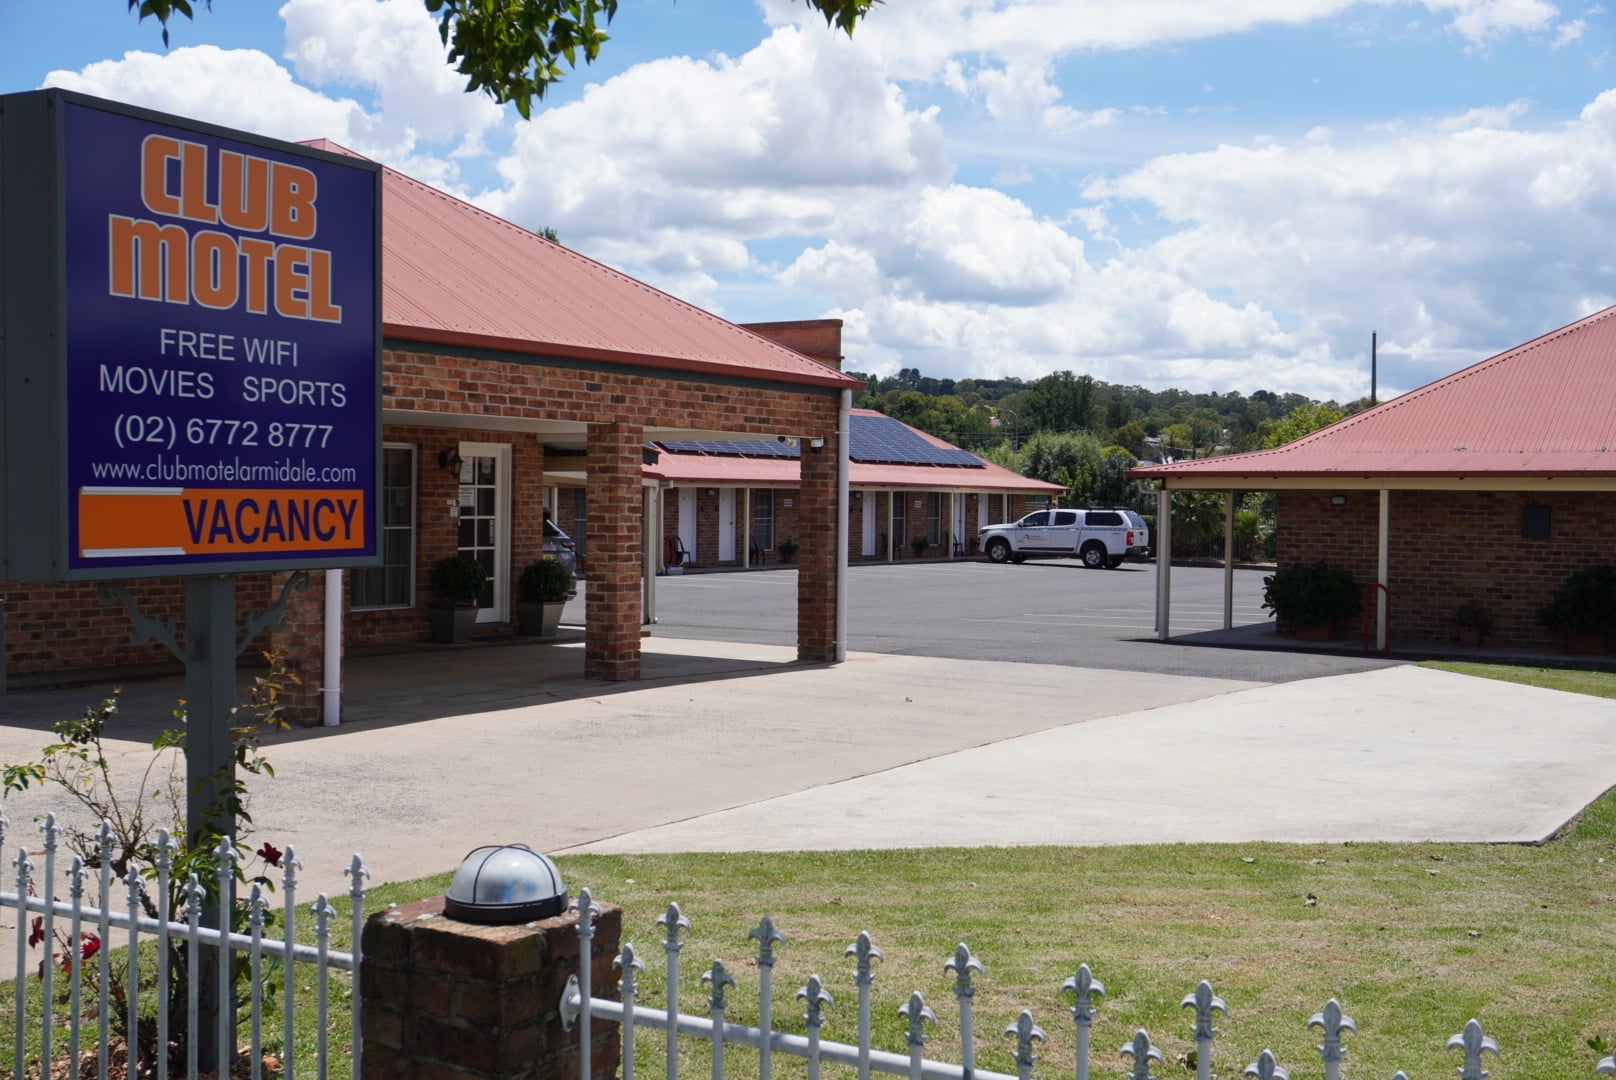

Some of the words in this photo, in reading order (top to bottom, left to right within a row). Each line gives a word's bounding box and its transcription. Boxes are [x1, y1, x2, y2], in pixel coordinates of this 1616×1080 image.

[141, 134, 317, 240] CLUB
[109, 214, 342, 324] MOTEL
[160, 328, 235, 361] FREE
[243, 337, 298, 367] WIFI
[99, 364, 214, 399] MOVIES
[242, 376, 346, 408] SPORTS
[114, 414, 177, 450] (02)
[186, 418, 258, 447] 6772
[268, 422, 333, 449] 8777
[92, 454, 356, 483] www.clubmotelarmidale.com
[183, 498, 358, 545] VACANCY
